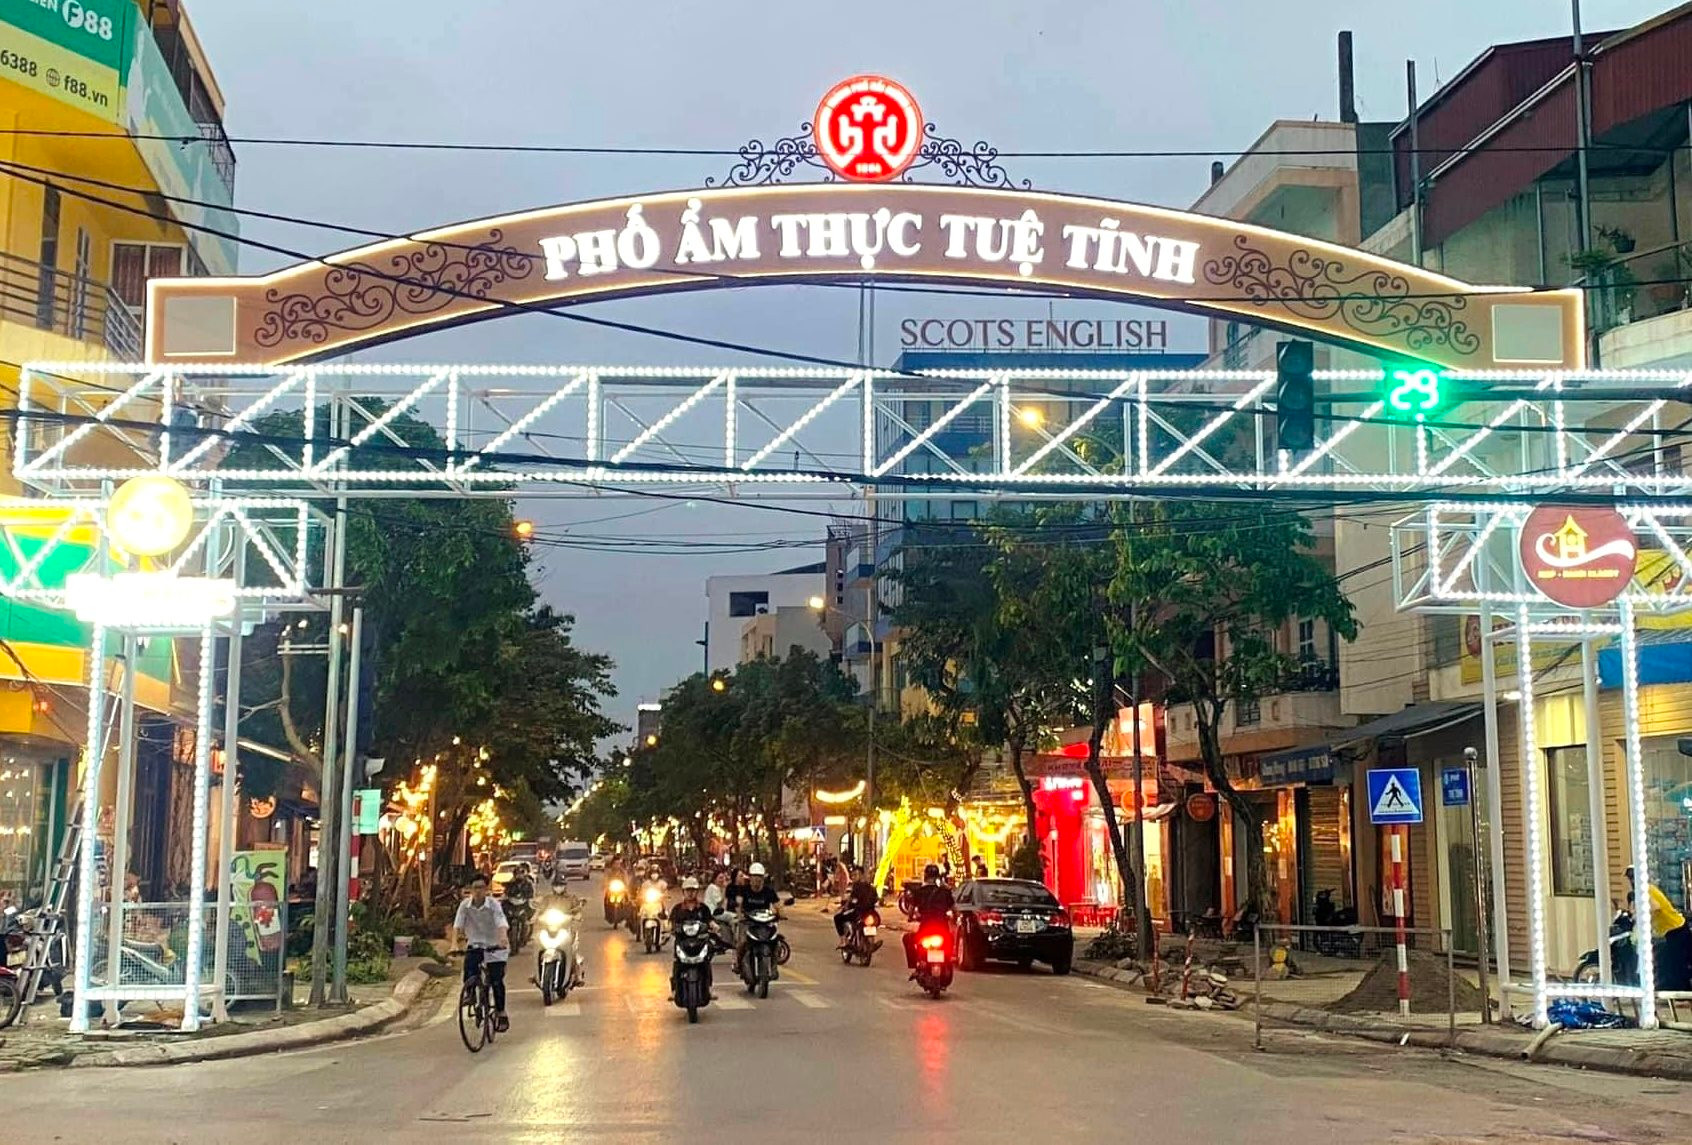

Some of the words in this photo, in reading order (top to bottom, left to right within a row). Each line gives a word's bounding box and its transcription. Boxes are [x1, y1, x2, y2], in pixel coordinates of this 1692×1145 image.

[62, 0, 113, 41] F88
[0, 50, 38, 77] 6388
[64, 75, 108, 108] f88.vn
[538, 203, 661, 281] PHỐ
[674, 197, 762, 264] ẨM
[771, 207, 923, 270] THỰC
[939, 209, 1045, 277] TUỆ
[1062, 217, 1200, 284] TĨNH
[900, 319, 1015, 347] SCOTS
[1027, 319, 1167, 348] ENGLISH
[1389, 369, 1439, 411] 29
